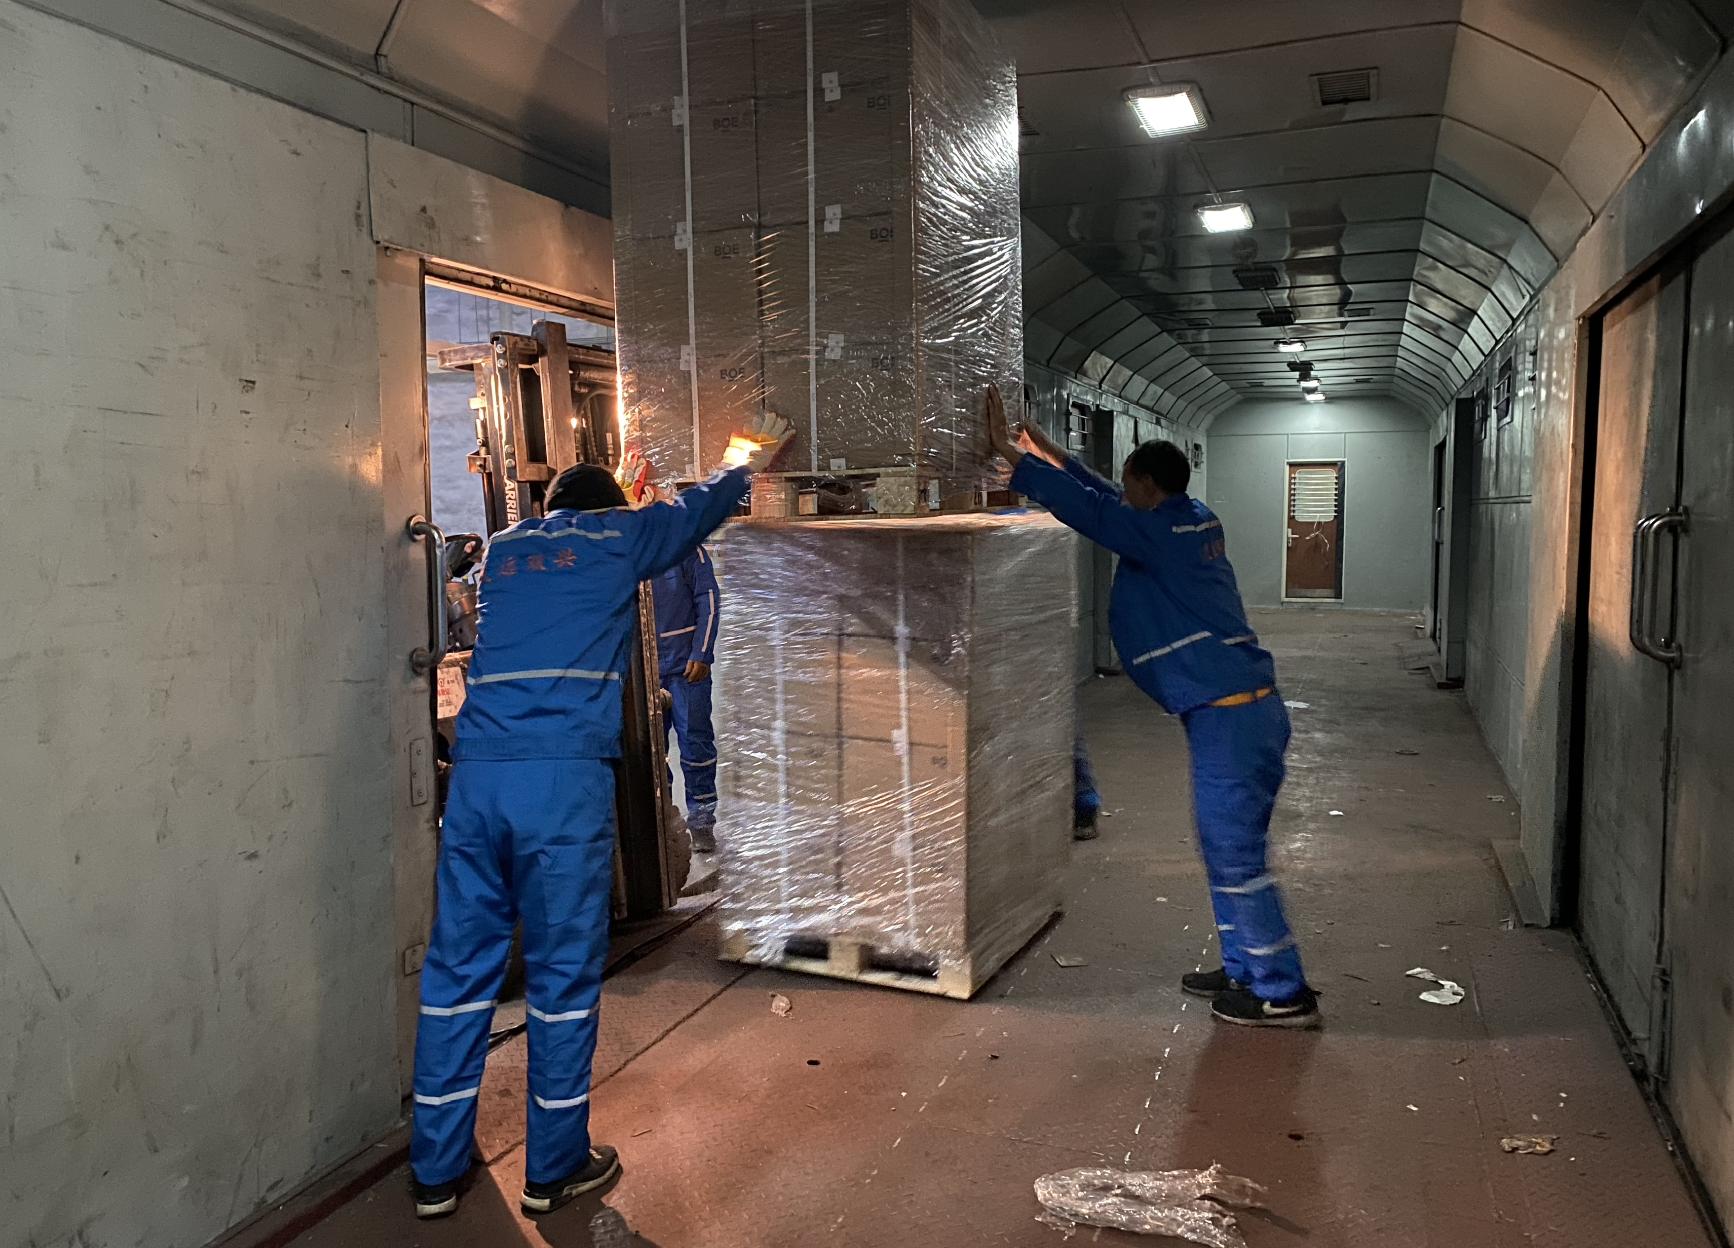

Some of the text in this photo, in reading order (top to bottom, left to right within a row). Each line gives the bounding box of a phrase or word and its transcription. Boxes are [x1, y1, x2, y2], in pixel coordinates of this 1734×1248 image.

[713, 116, 739, 132] BOE
[714, 243, 740, 259] BOE
[720, 367, 746, 383] BOE
